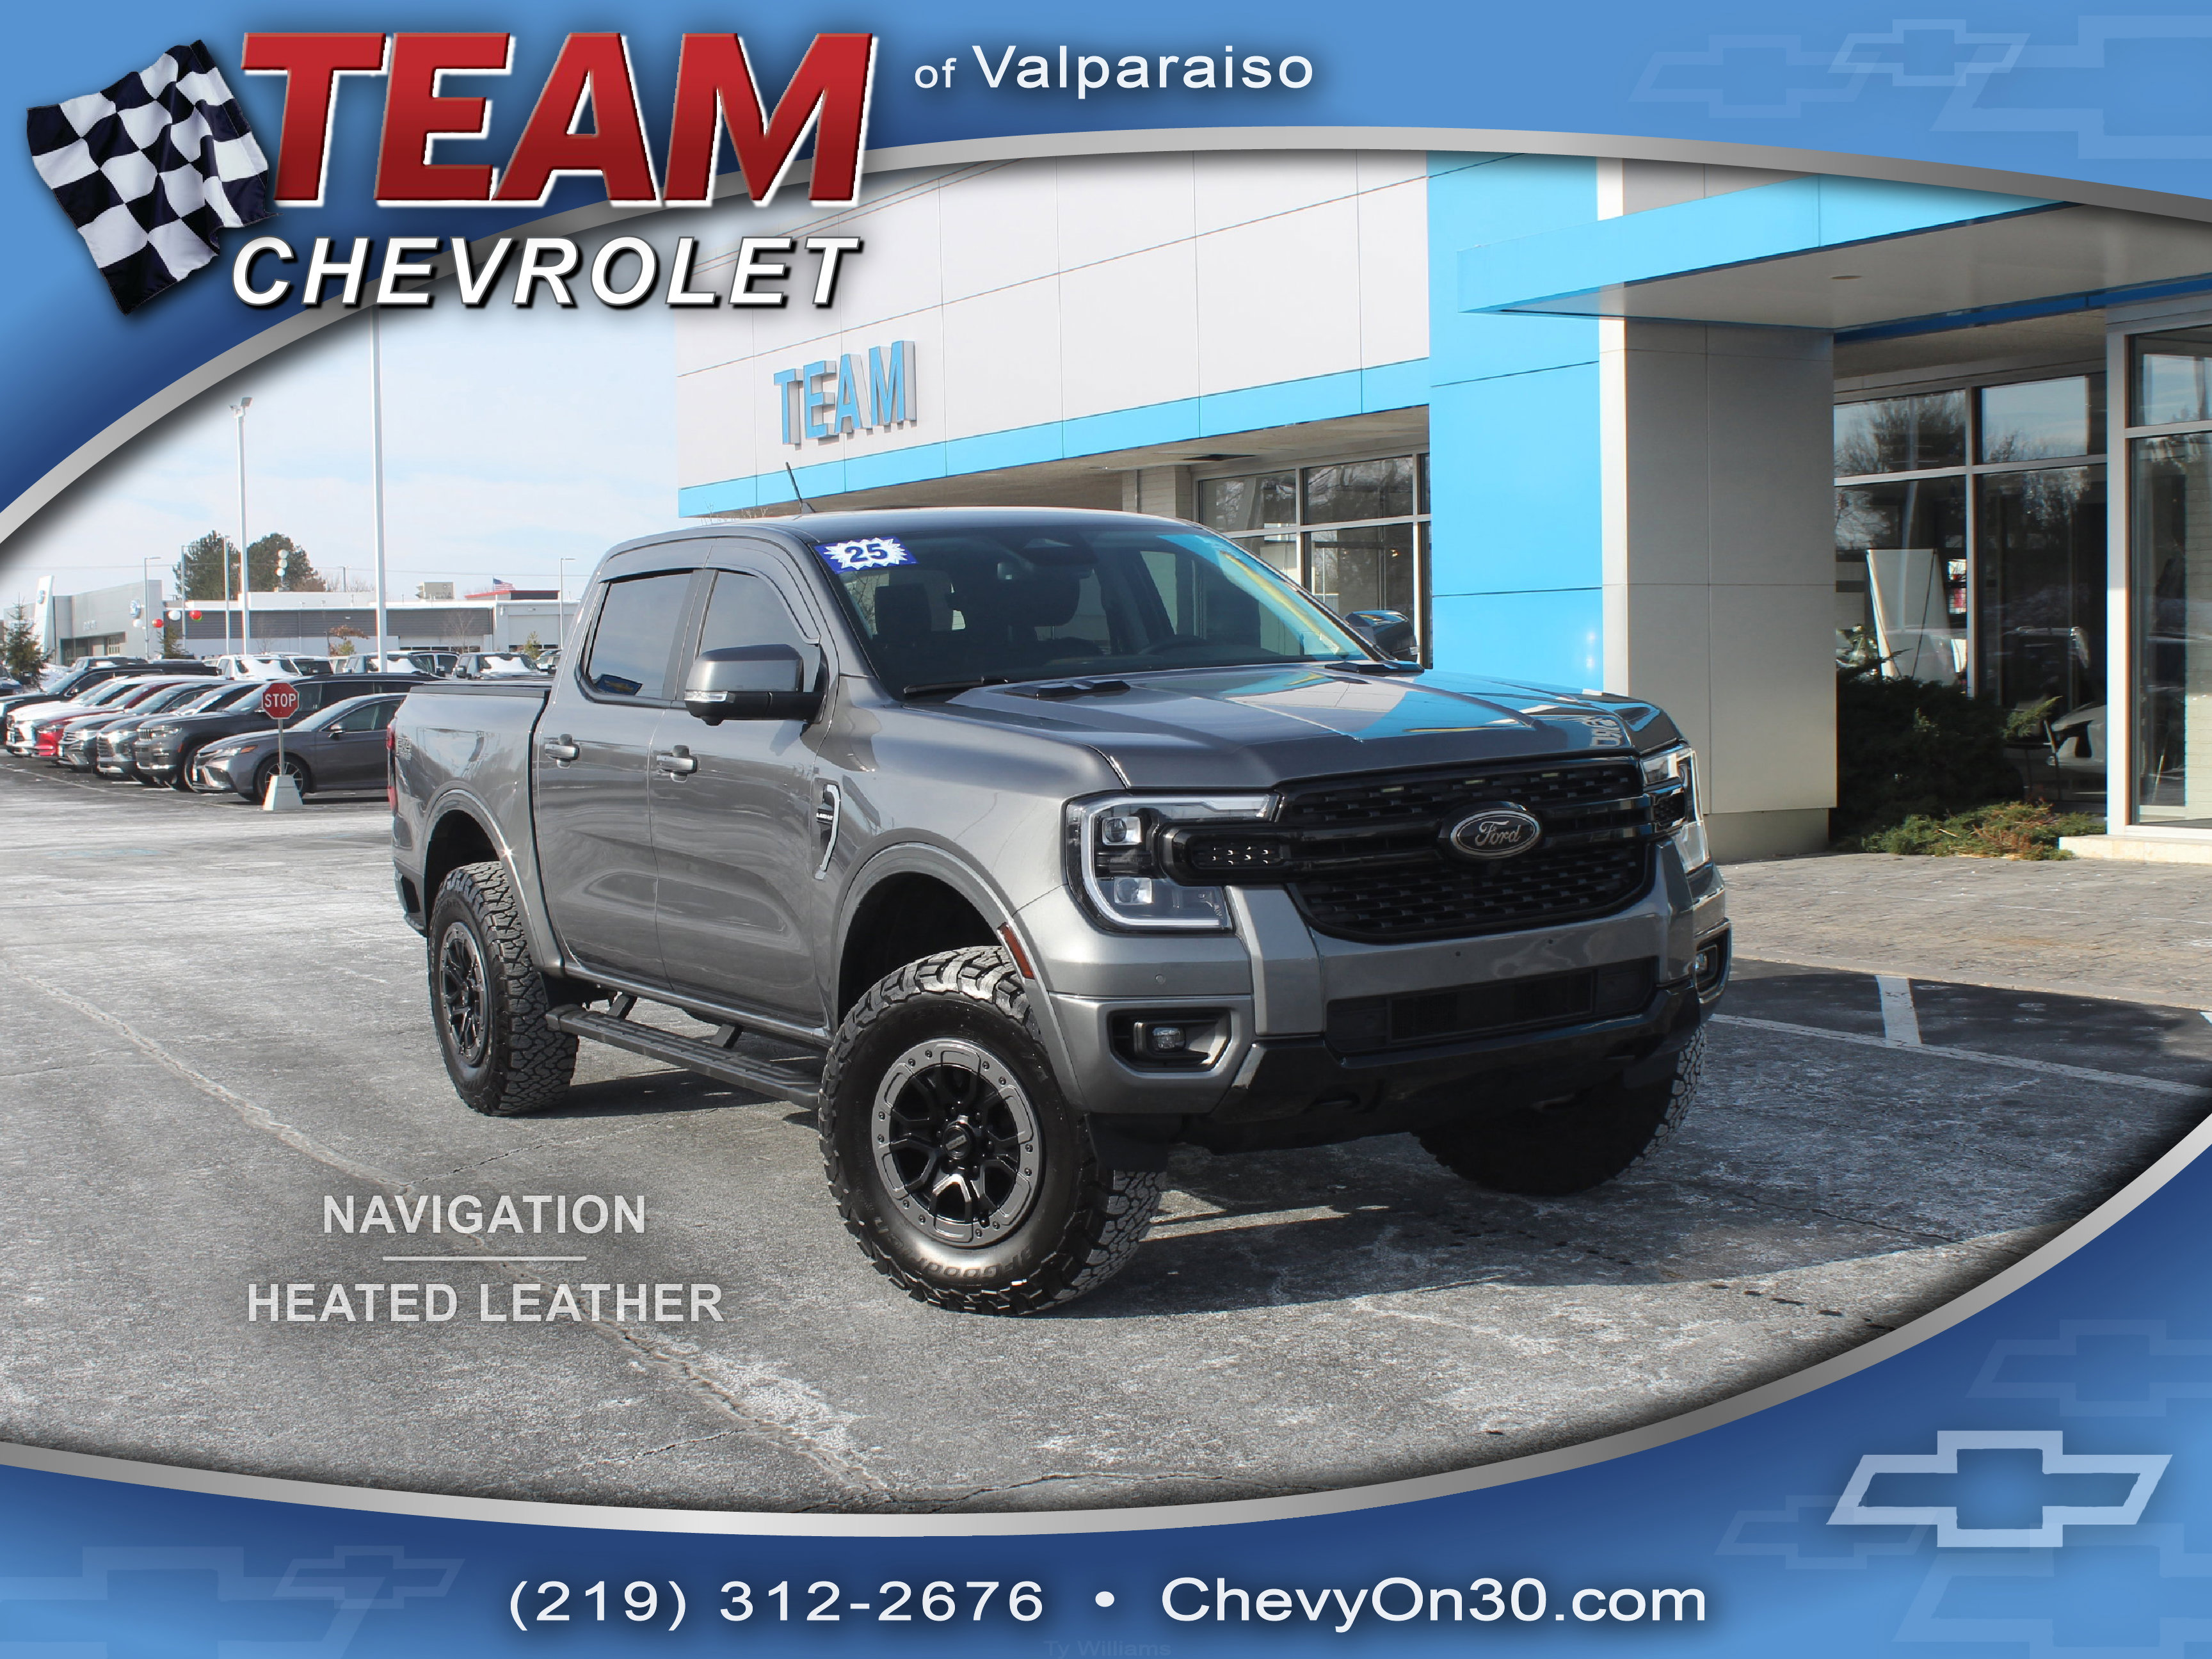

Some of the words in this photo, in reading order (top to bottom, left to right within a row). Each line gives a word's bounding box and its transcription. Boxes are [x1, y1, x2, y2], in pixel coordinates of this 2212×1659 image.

[773, 340, 917, 445] TEAM
[844, 543, 888, 563] 25
[264, 693, 296, 708] STOP
[1475, 820, 1521, 847] Ford
